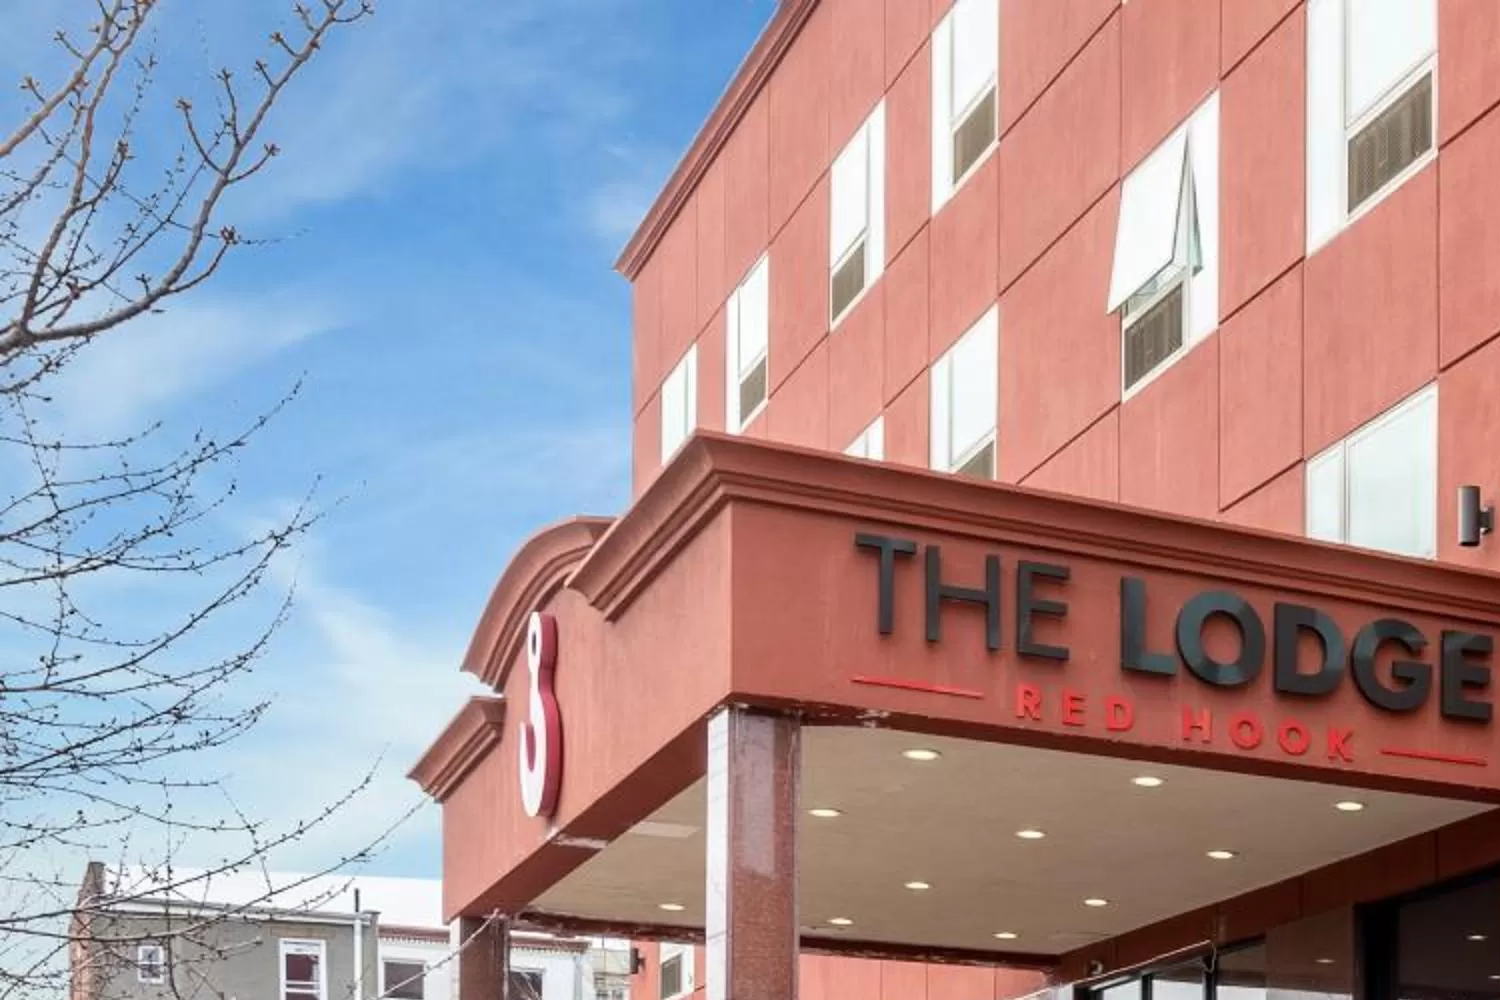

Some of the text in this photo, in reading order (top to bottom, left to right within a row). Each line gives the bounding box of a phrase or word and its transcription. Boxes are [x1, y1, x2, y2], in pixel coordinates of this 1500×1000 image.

[855, 533, 1494, 722] THE LODGE
[1015, 681, 1355, 763] RED HOOK
